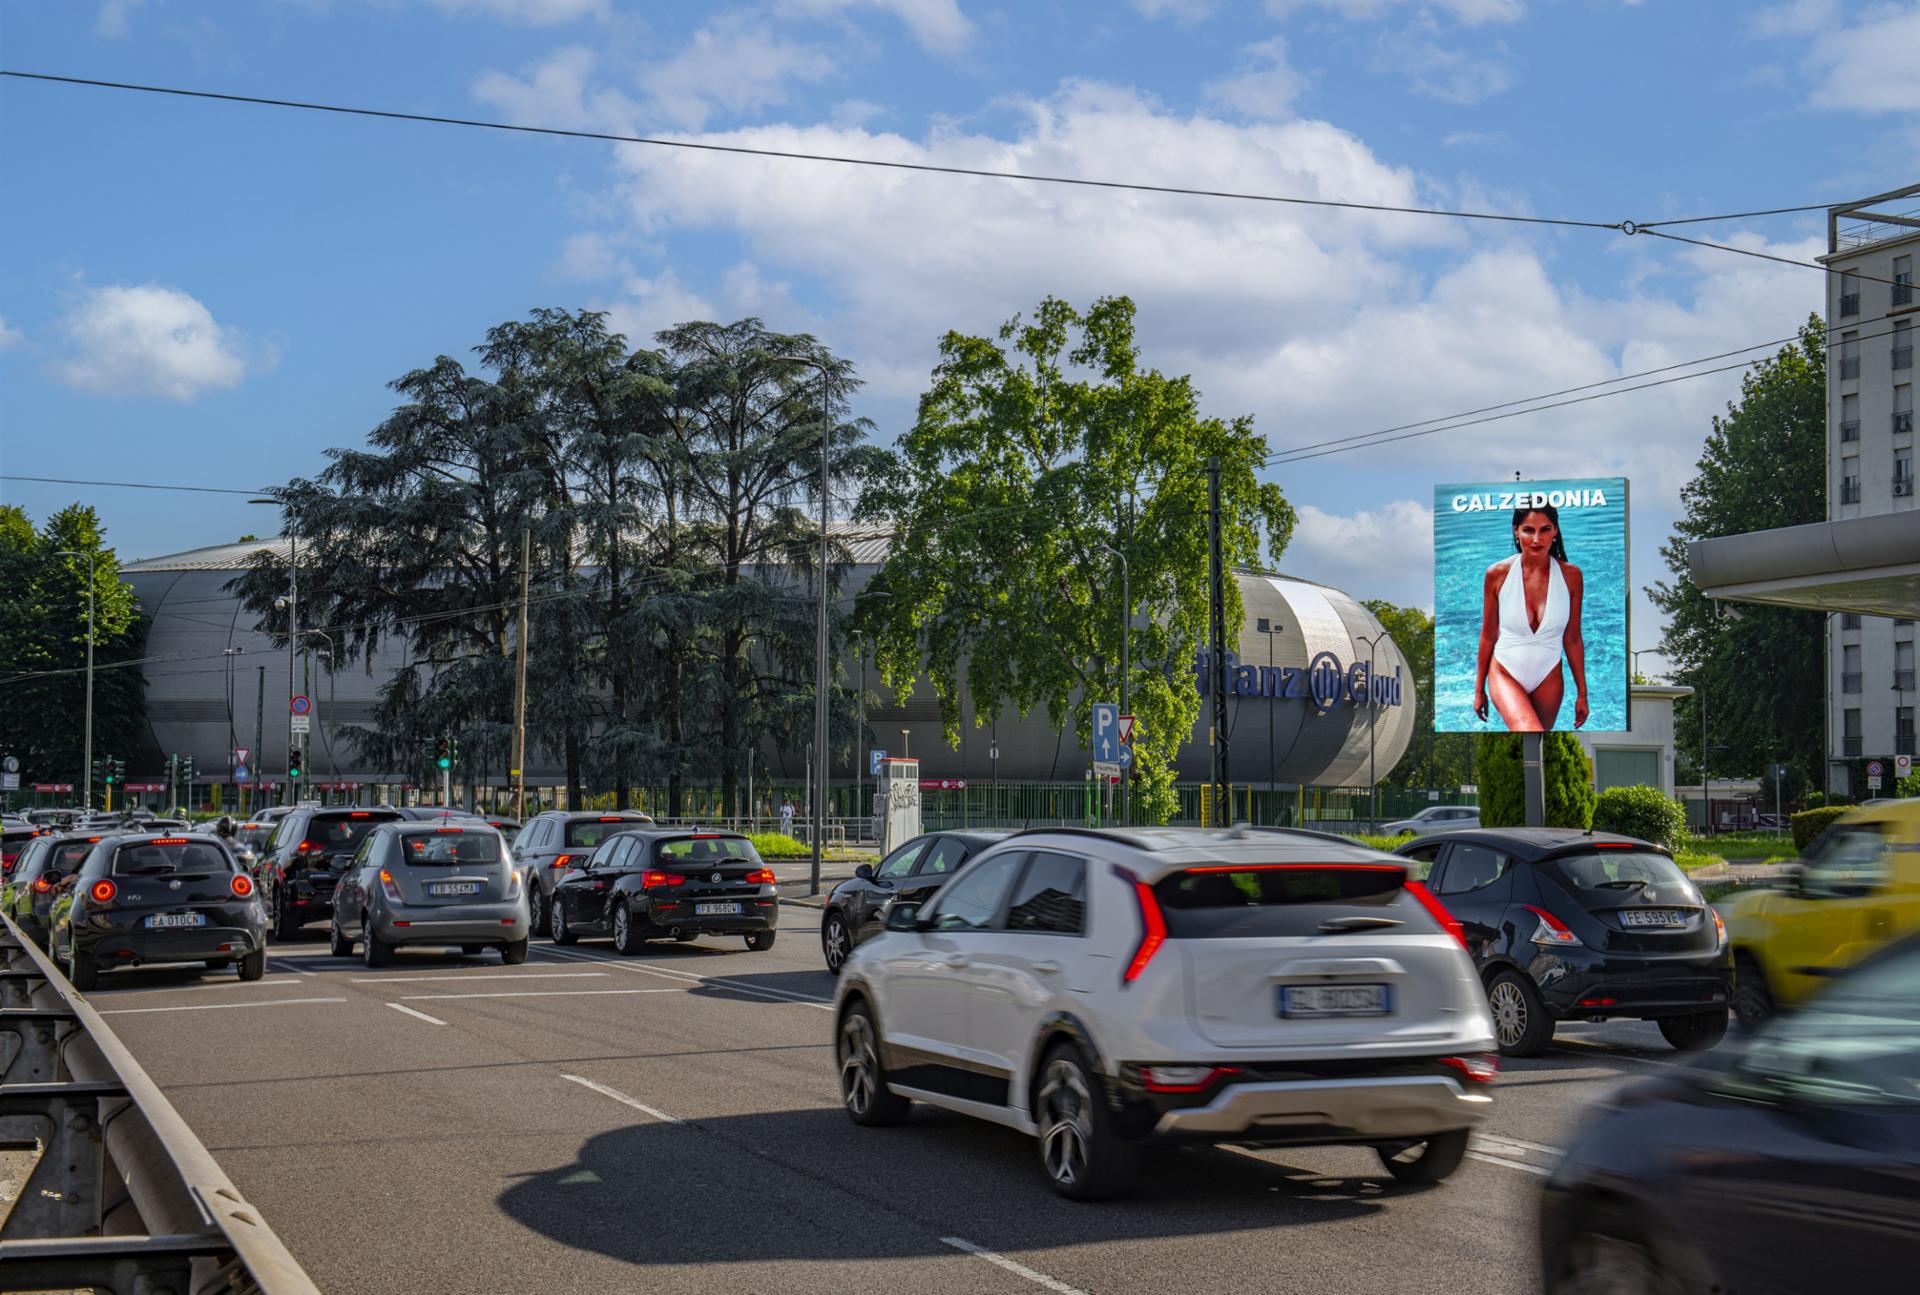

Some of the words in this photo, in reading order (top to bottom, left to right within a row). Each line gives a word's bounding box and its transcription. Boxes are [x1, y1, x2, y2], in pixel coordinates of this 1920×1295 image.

[1452, 489, 1608, 512] CALZEDONIA
[1162, 651, 1303, 698] lianz
[1347, 659, 1403, 707] Cloud
[1098, 708, 1113, 736] P
[873, 752, 883, 764] P
[152, 916, 164, 927] EA
[168, 914, 199, 926] 010CN
[1627, 911, 1642, 924] FE
[1644, 911, 1679, 924] 593VE
